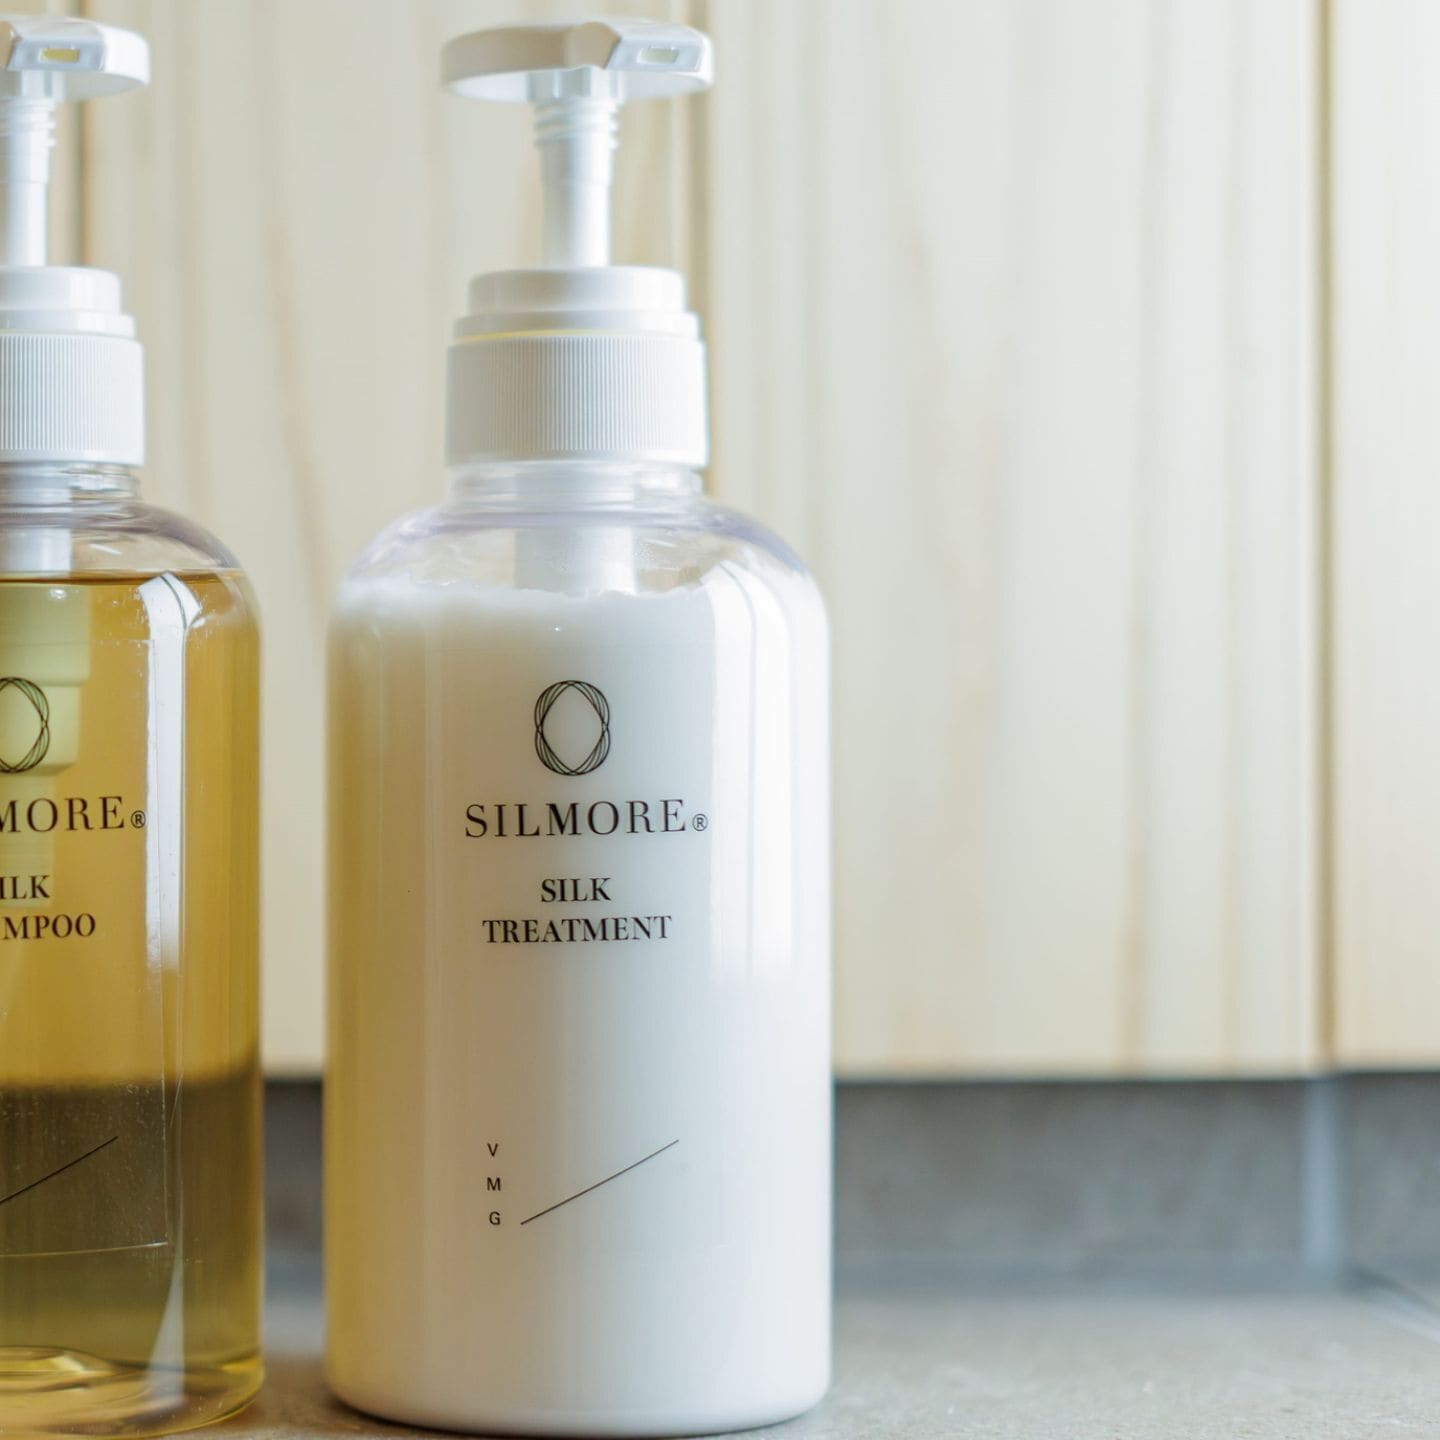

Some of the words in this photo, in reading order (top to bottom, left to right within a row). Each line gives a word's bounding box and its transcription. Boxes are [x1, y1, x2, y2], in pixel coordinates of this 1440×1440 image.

[540, 878, 612, 903] SILK
[482, 916, 672, 944] TREATMENT
[487, 1143, 499, 1157] V
[486, 1177, 502, 1191] M
[488, 1211, 501, 1227] G
